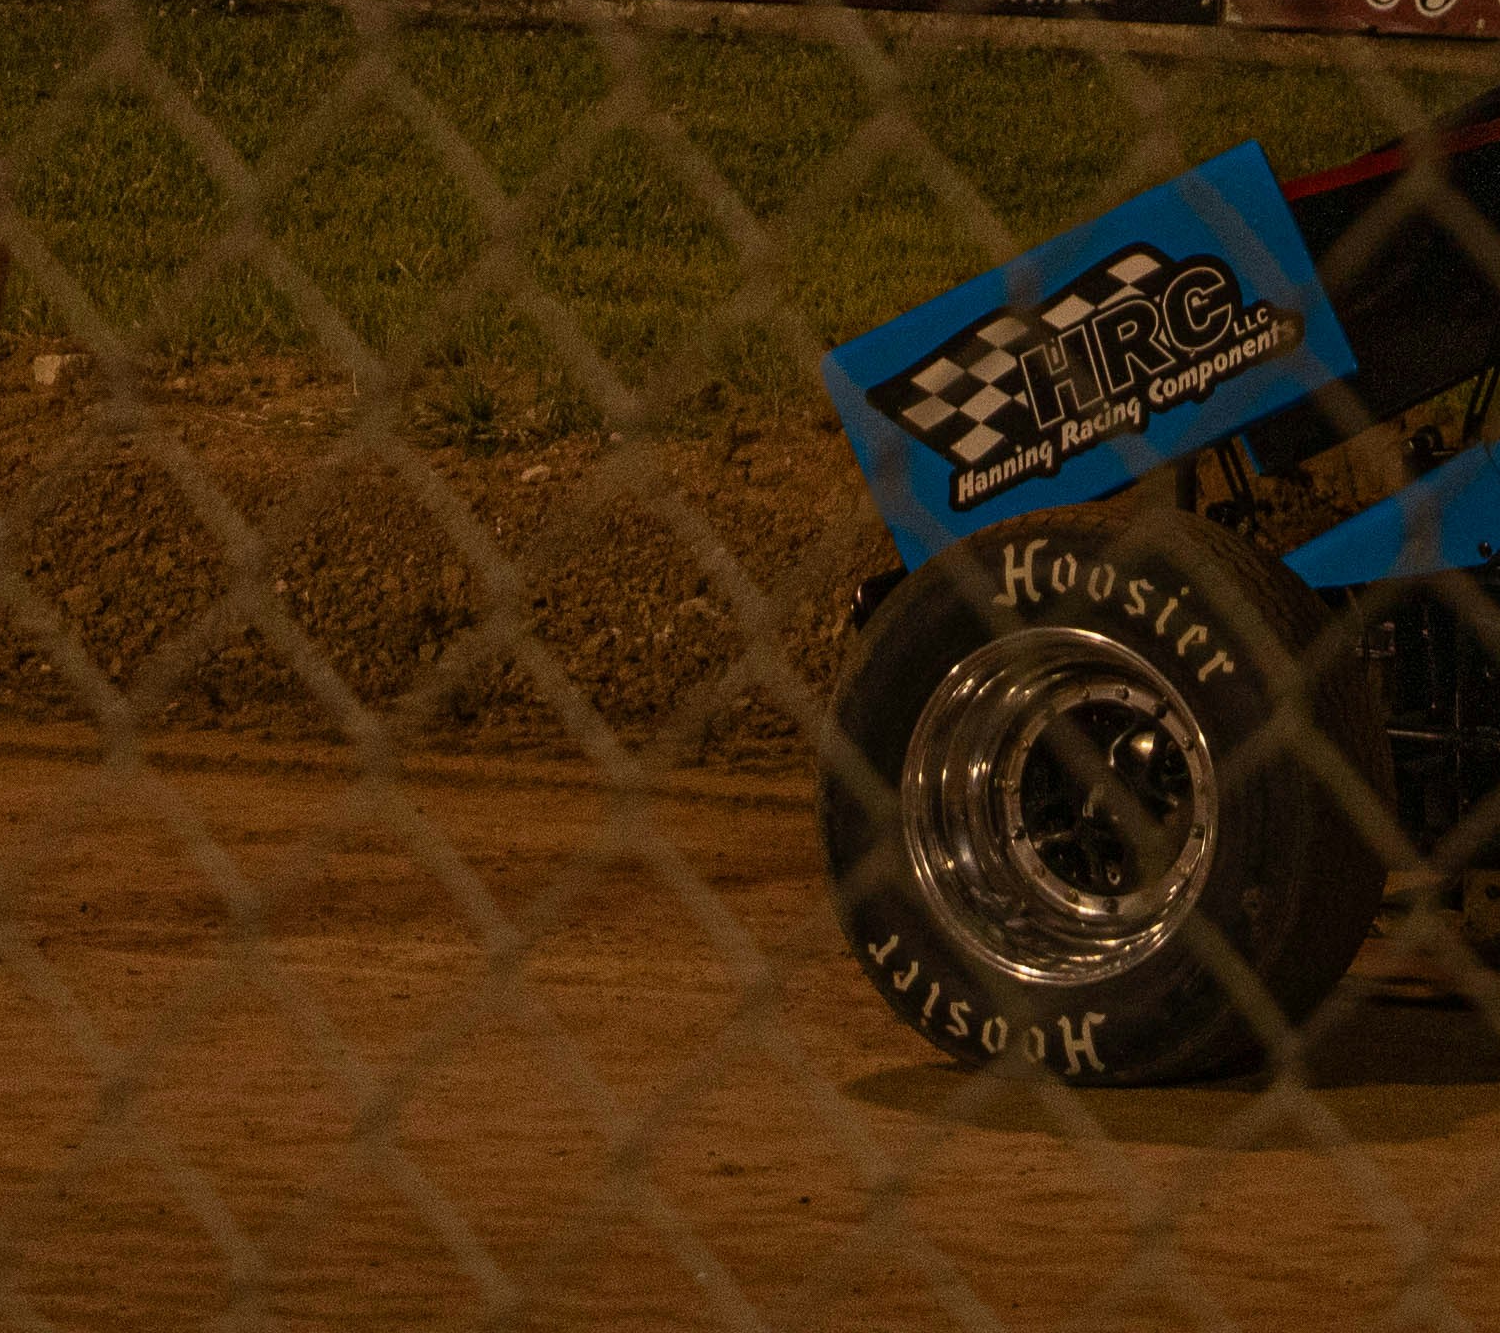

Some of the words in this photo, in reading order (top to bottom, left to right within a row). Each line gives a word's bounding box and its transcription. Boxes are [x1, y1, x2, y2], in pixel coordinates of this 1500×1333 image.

[1019, 265, 1234, 431] HRC
[1233, 306, 1270, 337] LLC
[957, 439, 1055, 504] Hanning
[1060, 395, 1142, 452] Racing
[994, 538, 1235, 684] Hoosier
[868, 933, 1108, 1076] Hoosier
